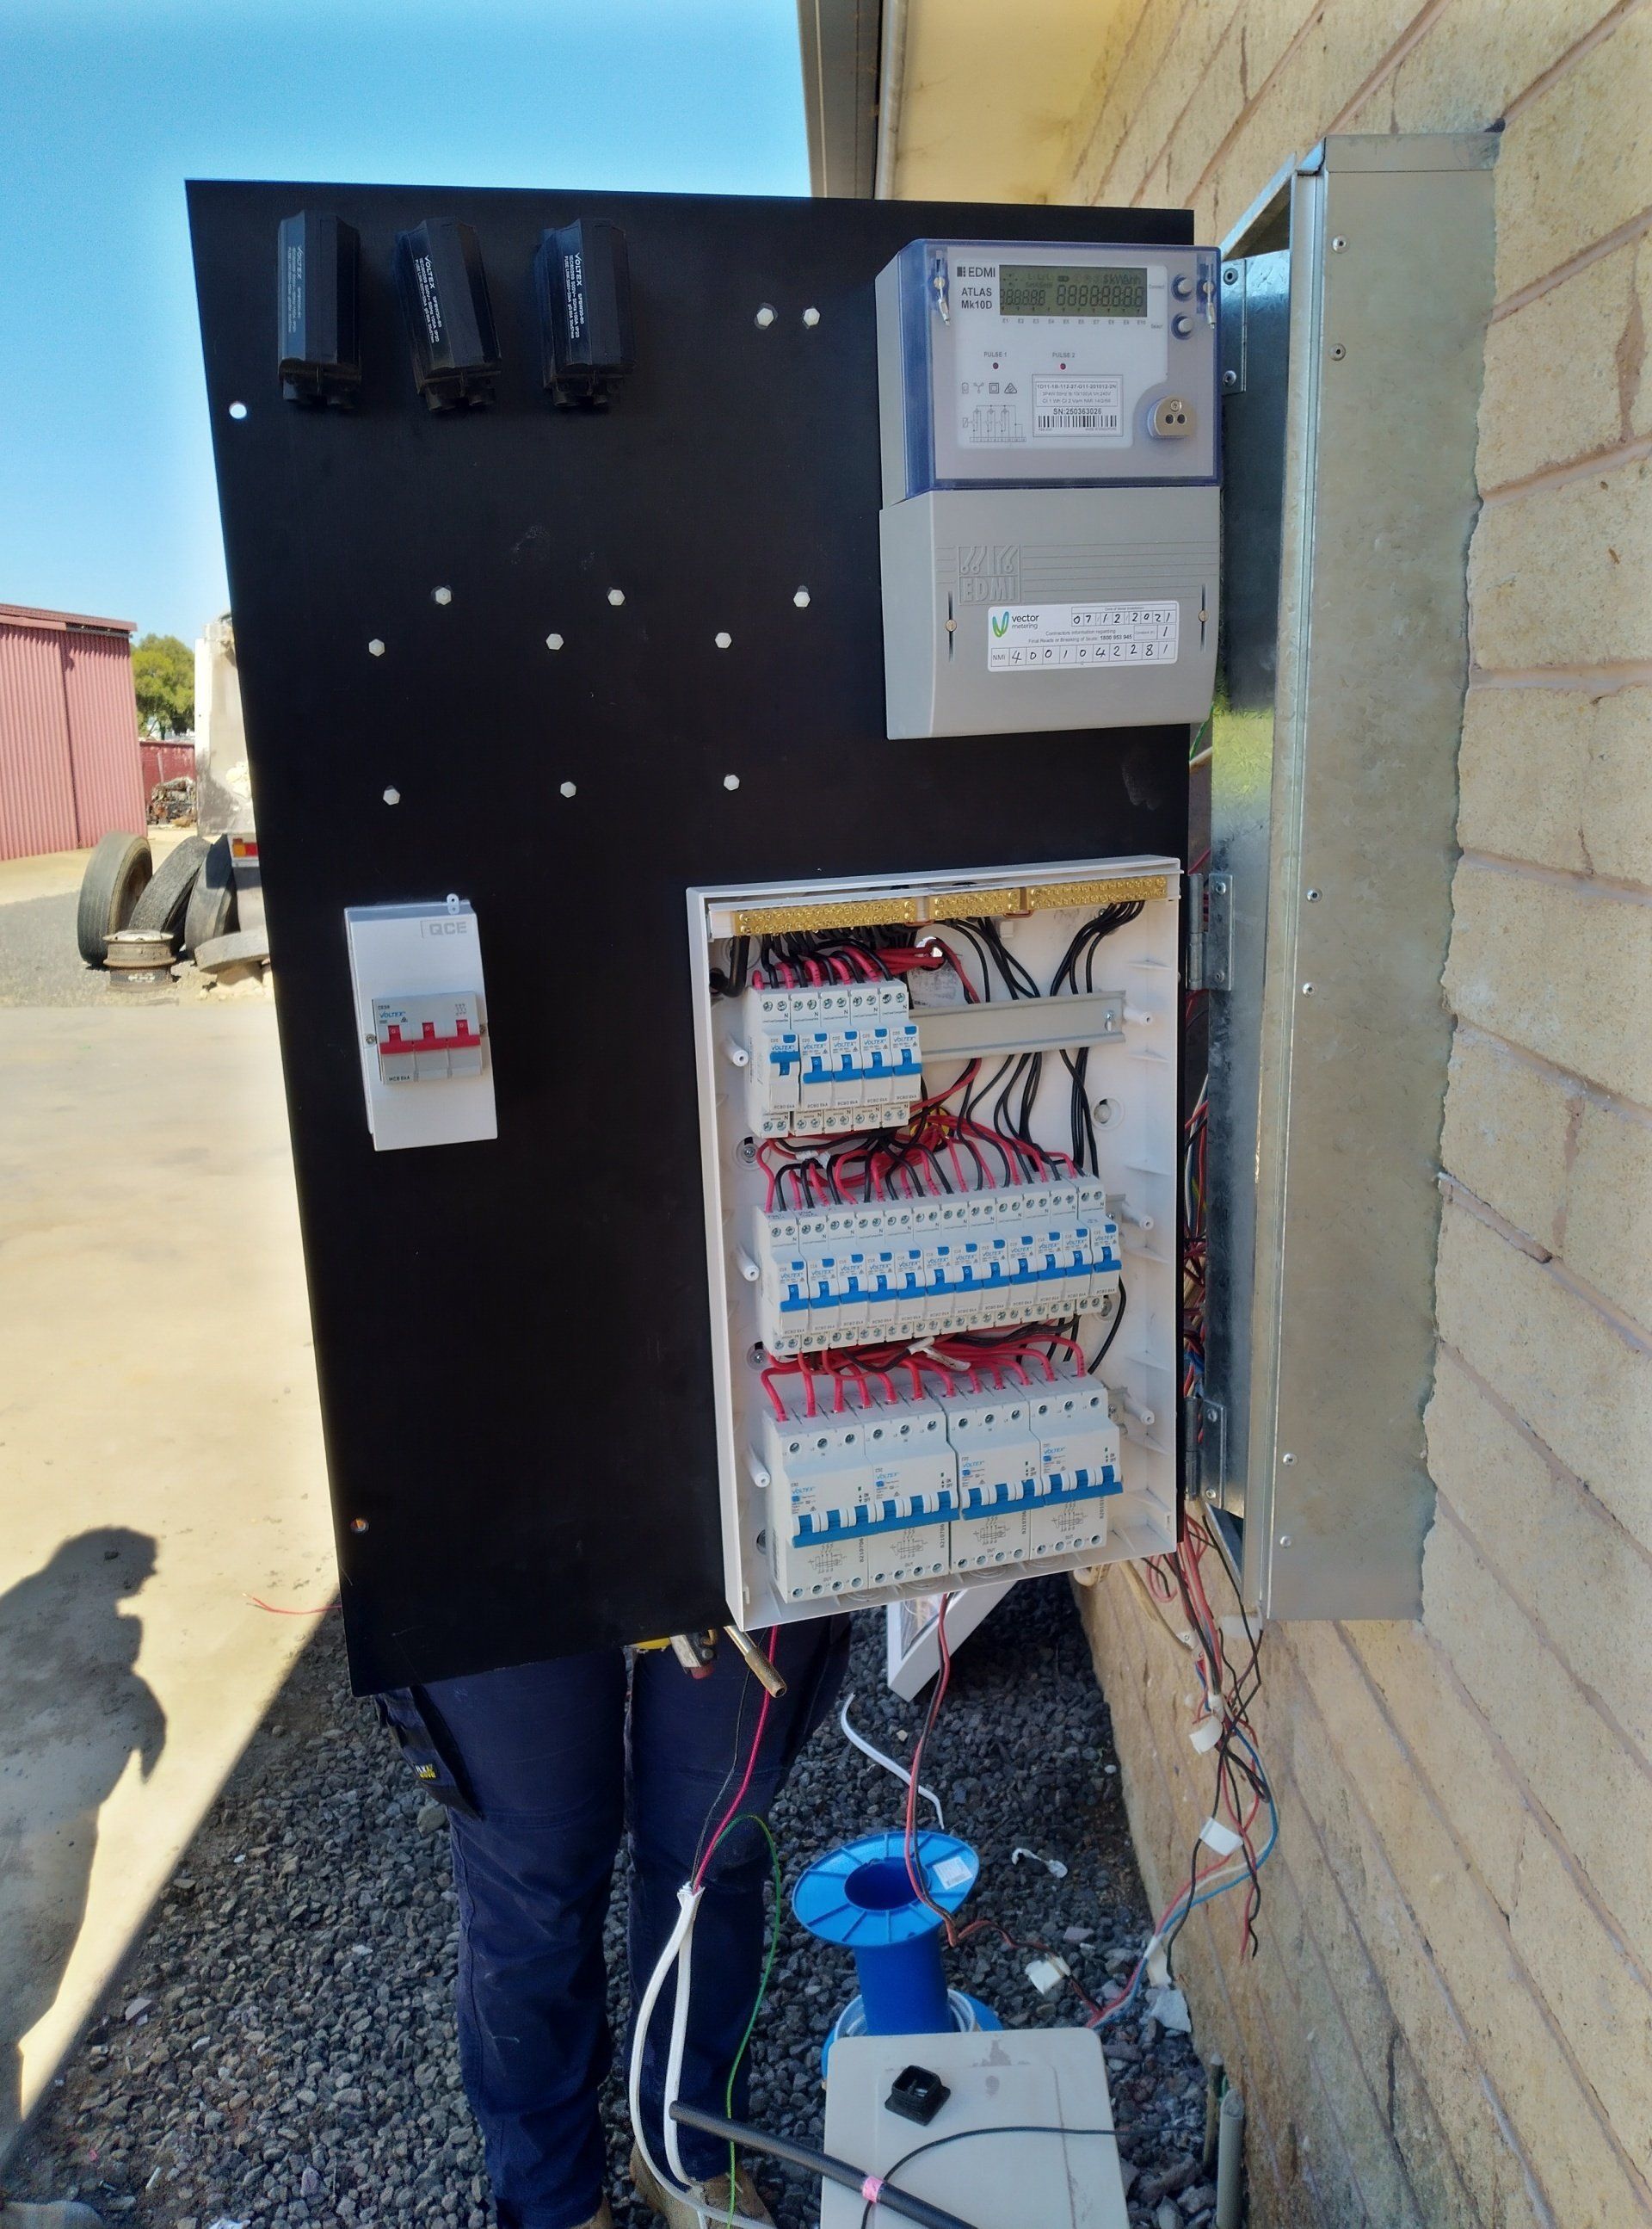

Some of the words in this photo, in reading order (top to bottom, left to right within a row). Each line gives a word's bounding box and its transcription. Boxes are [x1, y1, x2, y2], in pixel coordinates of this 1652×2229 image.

[425, 255, 435, 288] VOLTEX
[969, 267, 996, 277] EDMI
[962, 287, 992, 296] ATLAS
[961, 300, 992, 309] Mk10D
[963, 577, 1015, 602] EDMI
[429, 921, 467, 935] QCE
